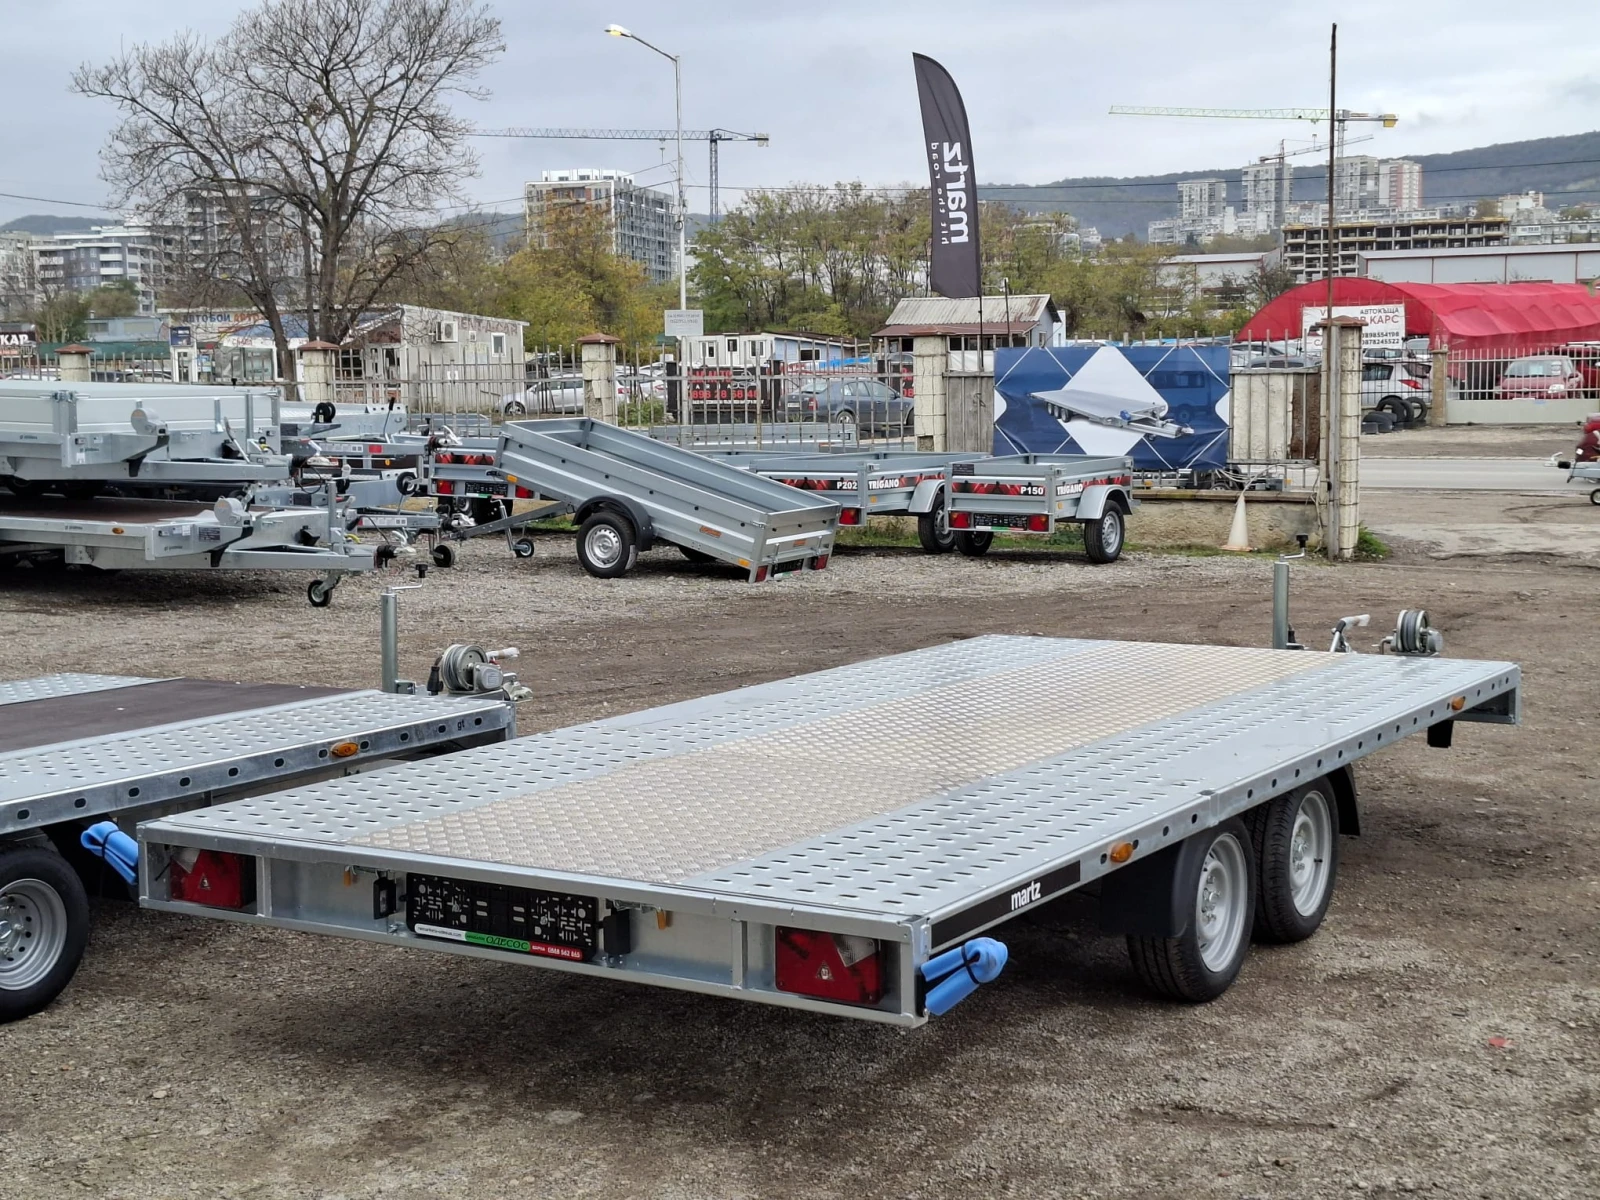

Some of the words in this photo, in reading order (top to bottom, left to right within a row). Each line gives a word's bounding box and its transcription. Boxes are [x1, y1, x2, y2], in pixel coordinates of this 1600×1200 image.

[1369, 315, 1399, 324] КАРС
[836, 481, 858, 490] P202
[868, 479, 900, 490] TRIGANO
[1020, 486, 1044, 495] P150
[1057, 483, 1083, 495] TRIGANO
[1010, 880, 1041, 911] martz
